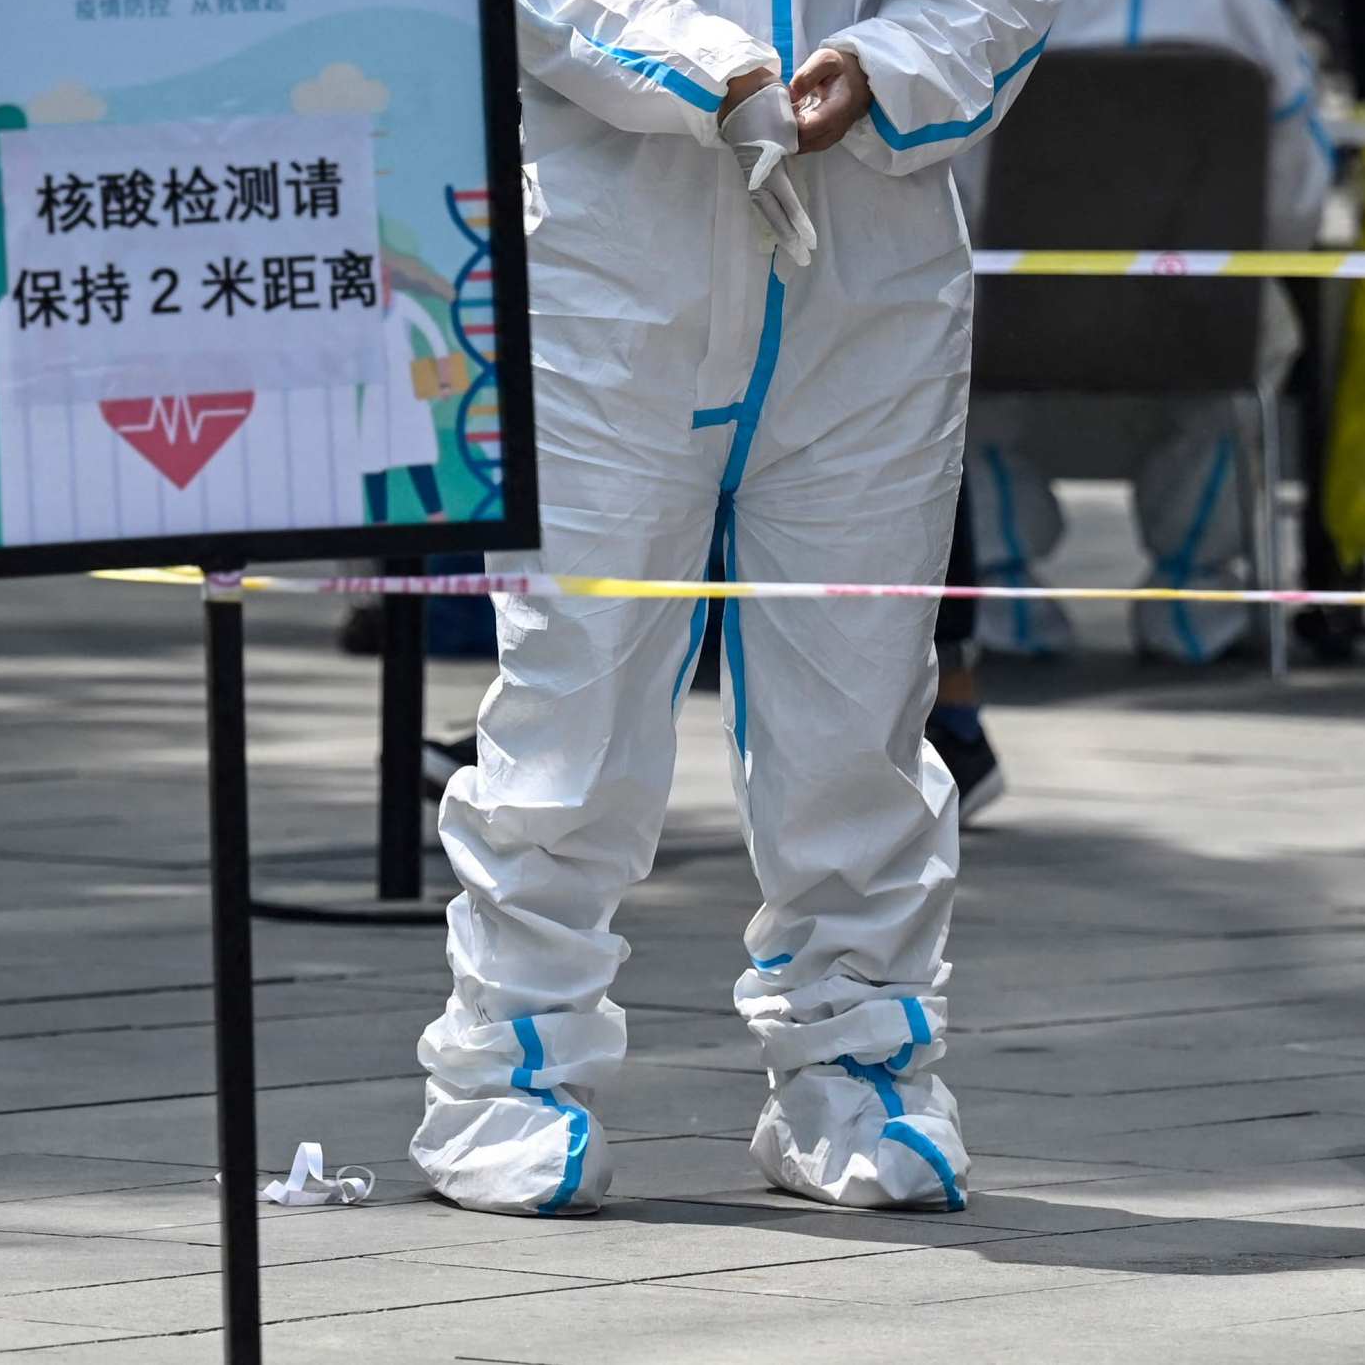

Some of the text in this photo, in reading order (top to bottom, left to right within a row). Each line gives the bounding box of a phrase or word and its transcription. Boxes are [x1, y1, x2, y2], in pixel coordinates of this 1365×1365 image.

[37, 158, 343, 235] 核酸检测请
